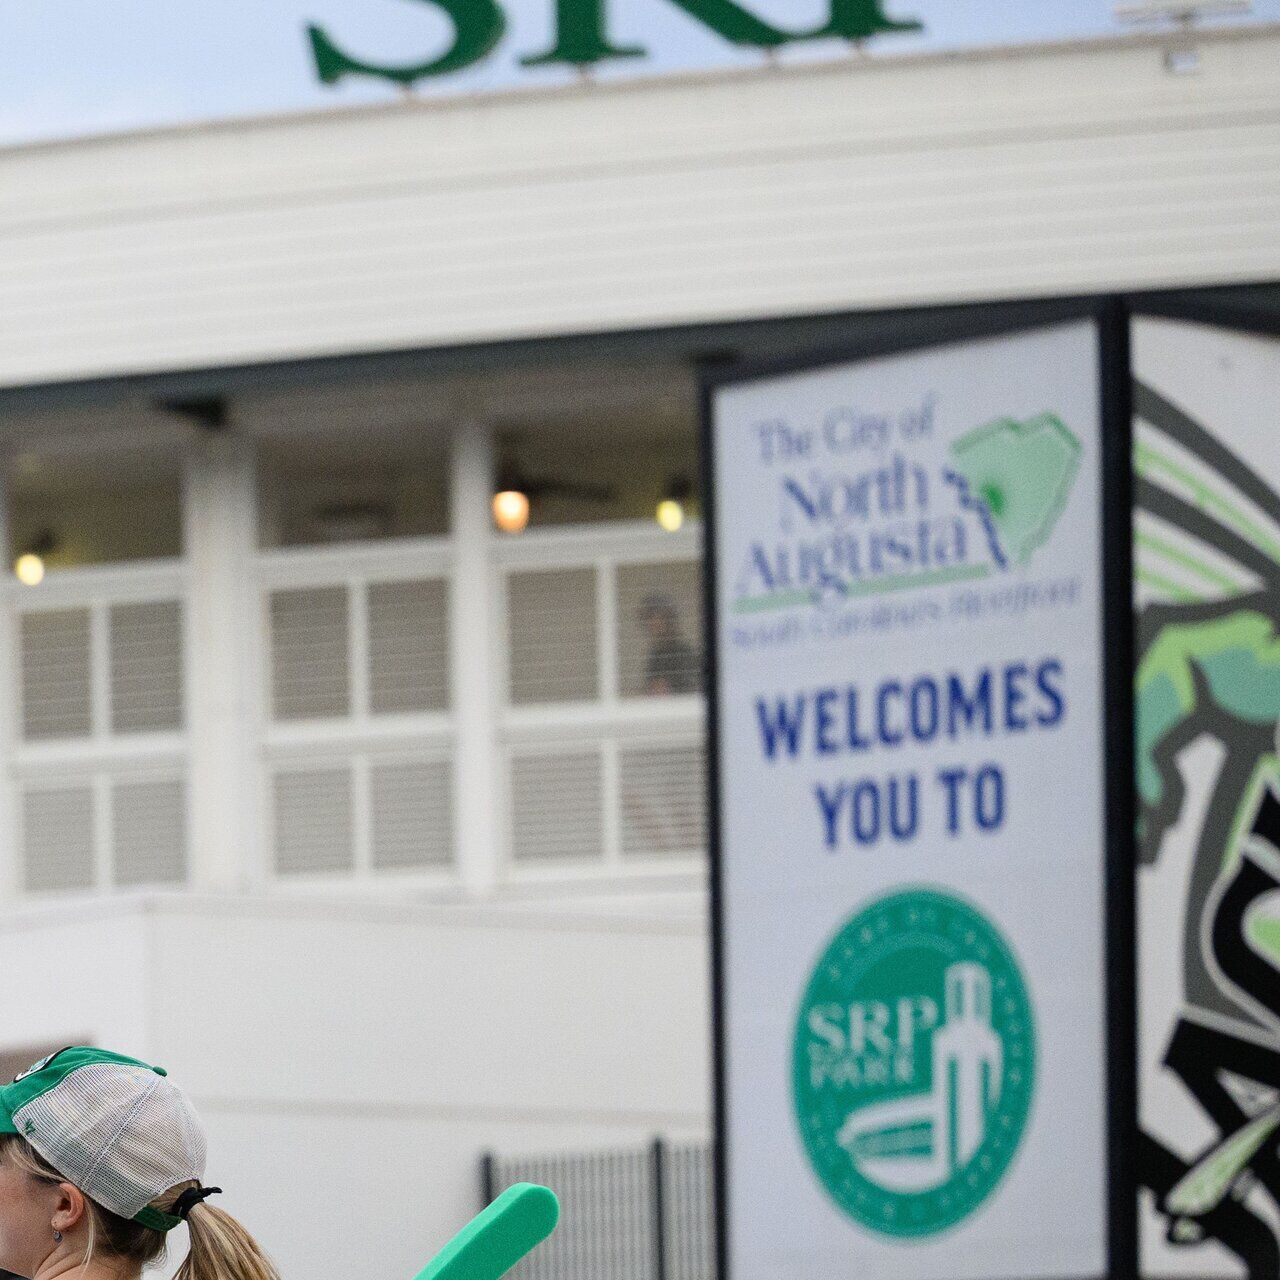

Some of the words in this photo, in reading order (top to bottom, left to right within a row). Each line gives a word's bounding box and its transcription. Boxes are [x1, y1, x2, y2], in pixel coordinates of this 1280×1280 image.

[755, 418, 811, 465] The
[822, 404, 897, 457] City
[899, 393, 937, 438] of
[780, 453, 928, 530] North
[735, 517, 967, 607] Augusta
[755, 656, 1066, 763] WELCOMES
[815, 773, 918, 852] YOU
[939, 763, 1006, 838] TO
[808, 996, 938, 1052] SRP
[808, 1043, 915, 1089] PARK
